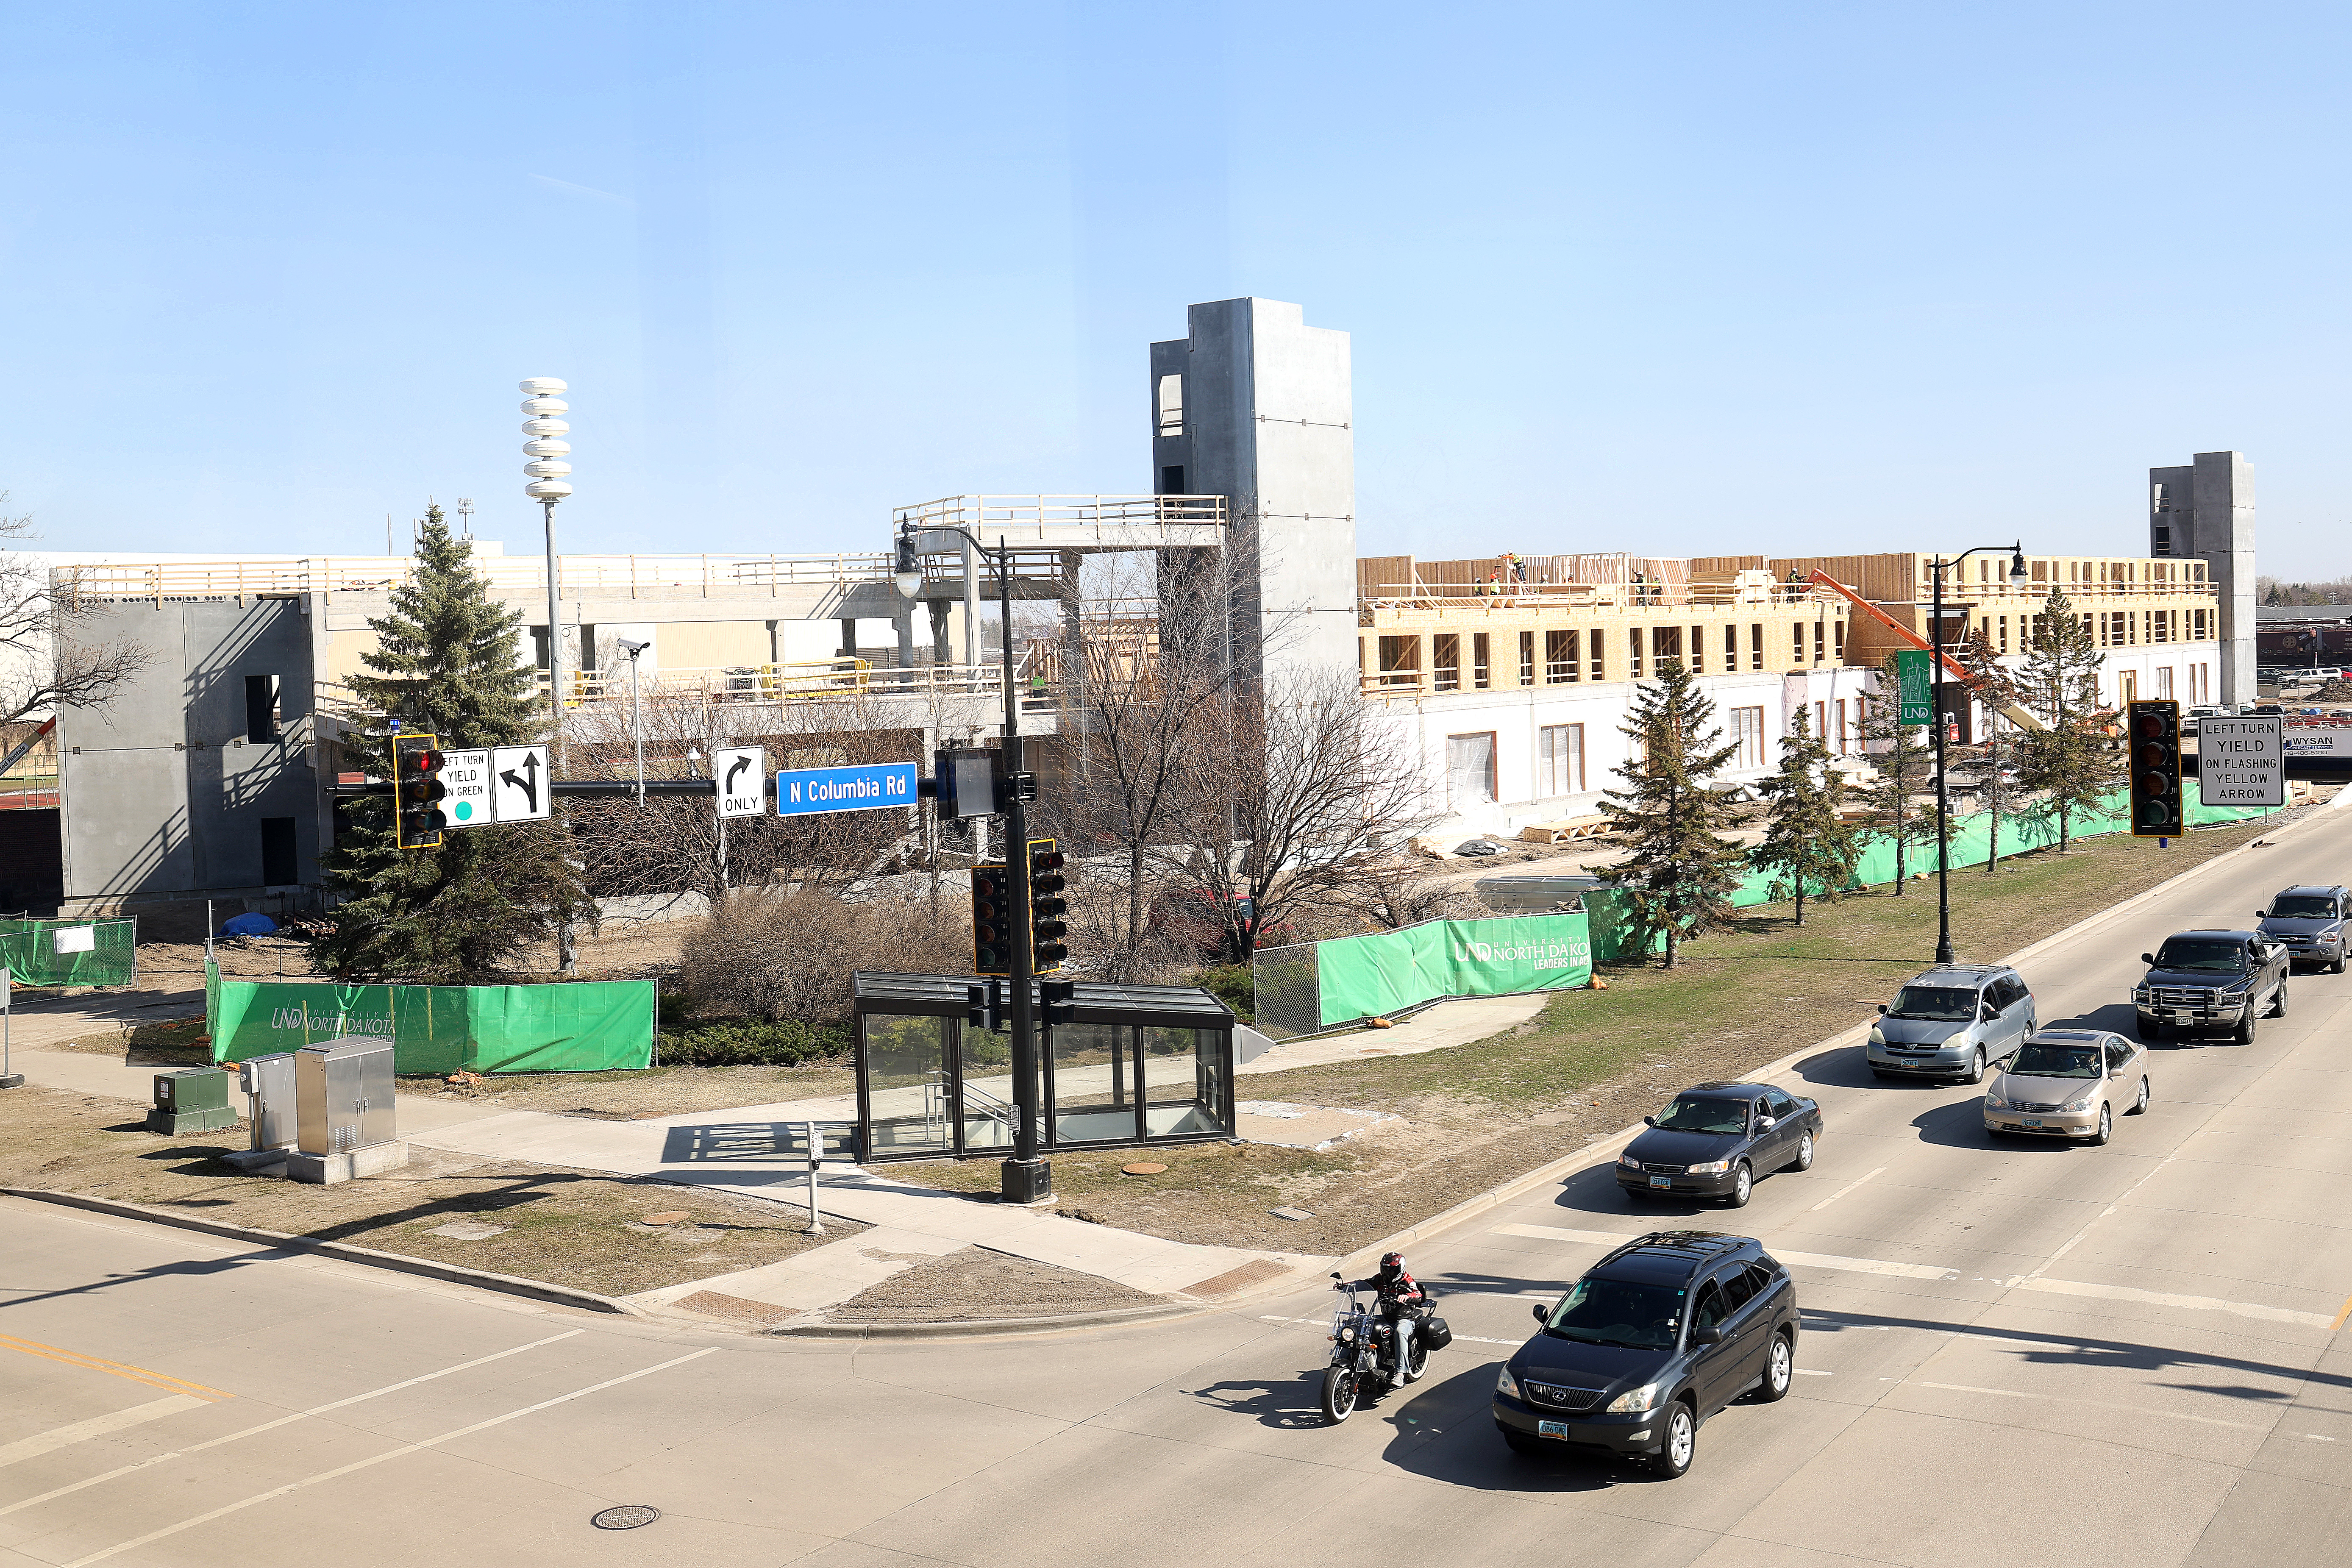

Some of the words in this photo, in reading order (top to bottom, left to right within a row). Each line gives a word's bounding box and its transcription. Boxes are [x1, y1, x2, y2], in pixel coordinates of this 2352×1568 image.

[1904, 707, 1929, 718] UND
[2205, 724, 2235, 734] LEFT
[2241, 723, 2274, 734] TURN
[2217, 740, 2264, 752] YIELD
[7, 746, 25, 763] Rentals
[444, 756, 458, 766] EFT
[463, 755, 484, 765] TURN
[2206, 759, 2219, 769] ON
[2225, 759, 2277, 768] FLASHING
[448, 770, 476, 782] YIELD
[2215, 774, 2269, 784] YELLOW
[457, 785, 483, 796] GREEN
[790, 782, 801, 803] N
[809, 778, 880, 801] Columbia
[887, 775, 905, 795] Rd
[2219, 789, 2265, 799] ARROW
[726, 797, 758, 811] ONLY
[1494, 936, 1582, 948] UNIVERSITY
[1454, 942, 1492, 962] UND
[1494, 945, 1545, 962] NORTH
[1549, 942, 1590, 957] DAKO
[1534, 957, 1568, 970] LEADERS
[1570, 956, 1578, 967] IN
[272, 1008, 303, 1029] UND
[347, 1018, 396, 1034] DAKOTA
[1542, 1425, 1554, 1433] 086
